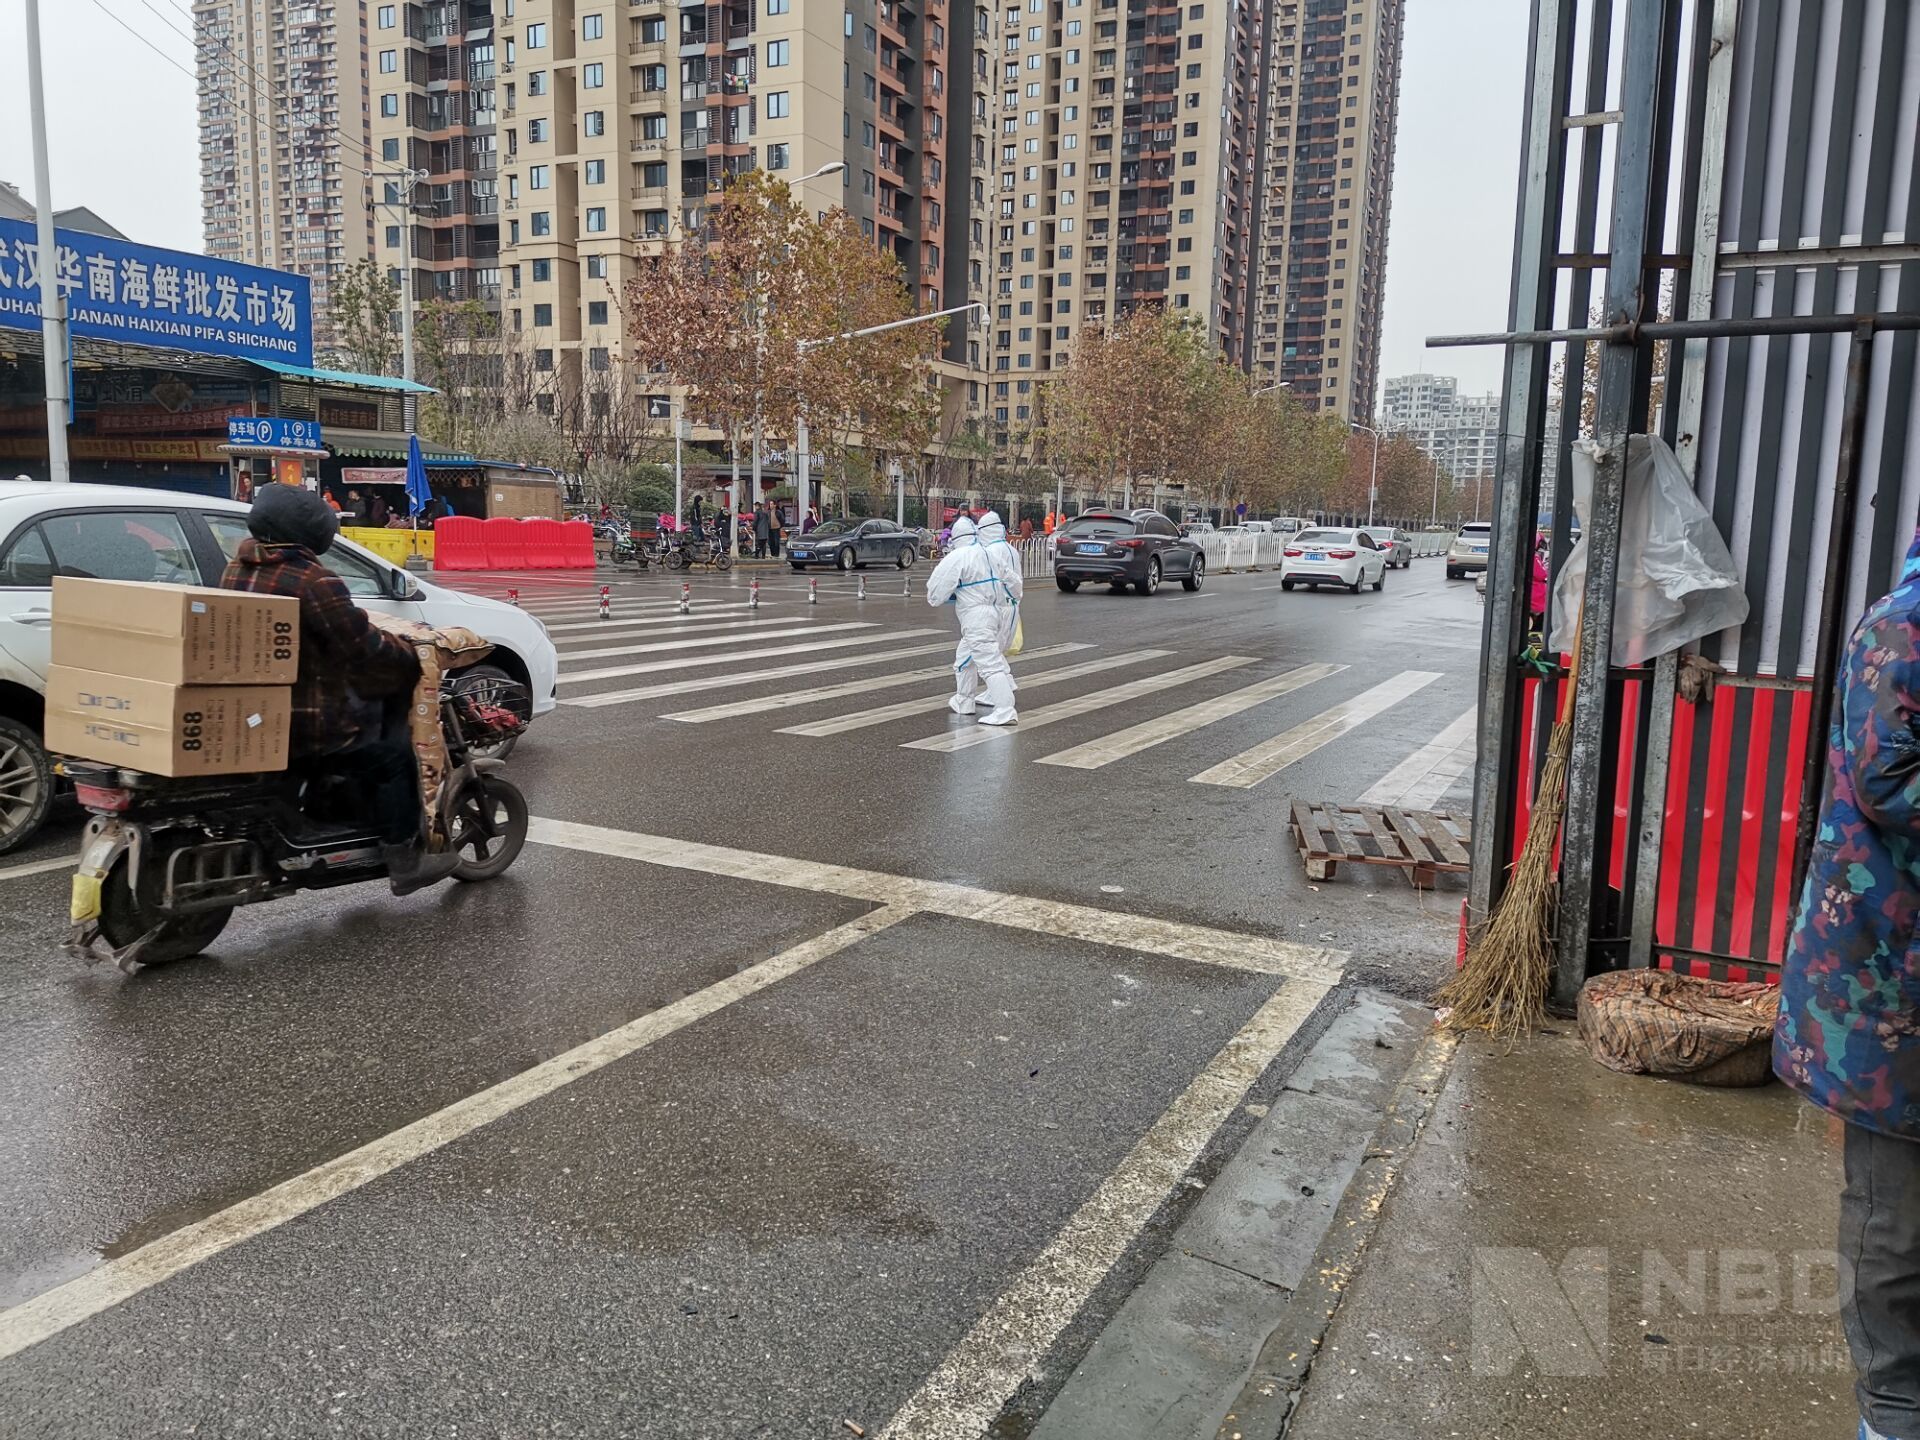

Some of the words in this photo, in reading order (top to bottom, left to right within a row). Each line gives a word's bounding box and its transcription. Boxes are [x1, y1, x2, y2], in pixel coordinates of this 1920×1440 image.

[0, 297, 42, 316] UHA
[128, 316, 191, 337] HAIXIAN
[194, 326, 225, 342] PIFA
[227, 330, 297, 353] SHICHANG
[229, 421, 255, 436] 停车场
[280, 436, 317, 448] 停车场
[273, 622, 292, 660] 868
[183, 711, 203, 751] 868
